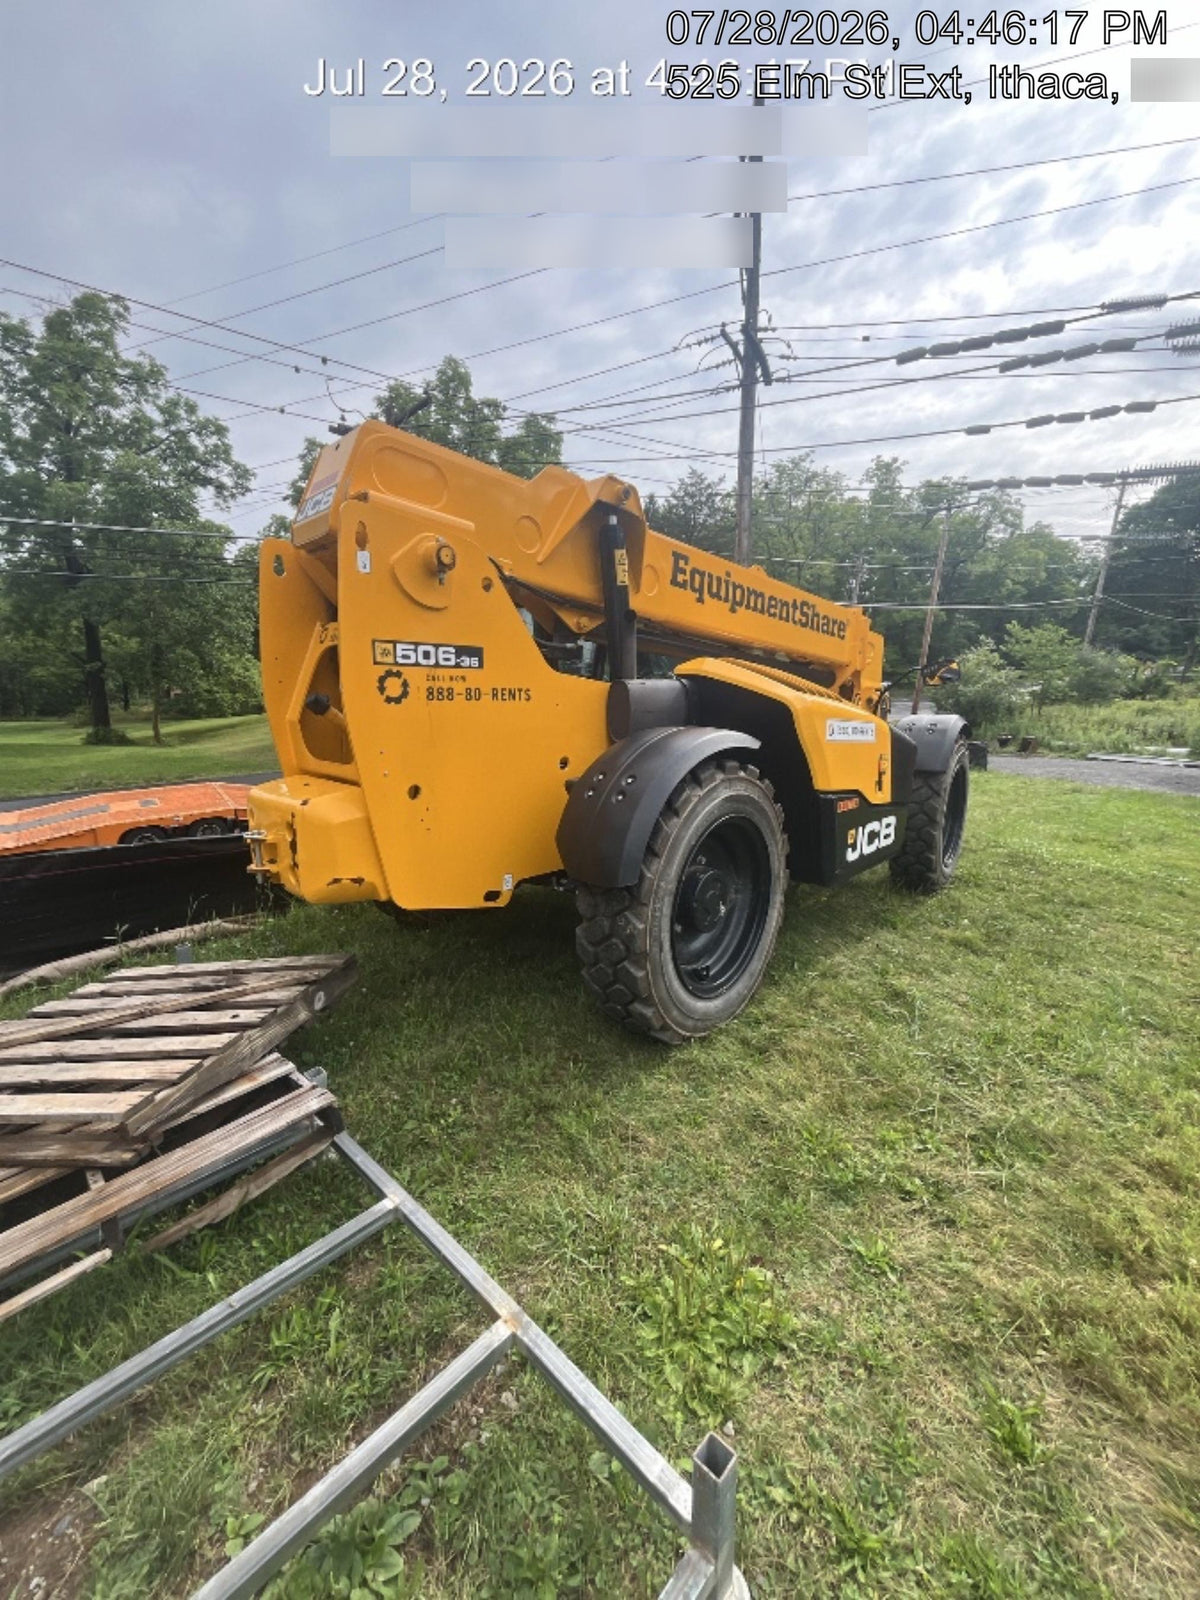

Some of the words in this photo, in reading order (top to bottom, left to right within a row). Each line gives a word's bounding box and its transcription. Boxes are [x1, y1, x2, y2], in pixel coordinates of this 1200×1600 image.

[670, 550, 847, 640] EquipmentShare
[426, 686, 532, 702] 888-80-RENTS
[846, 815, 897, 862] JCB
